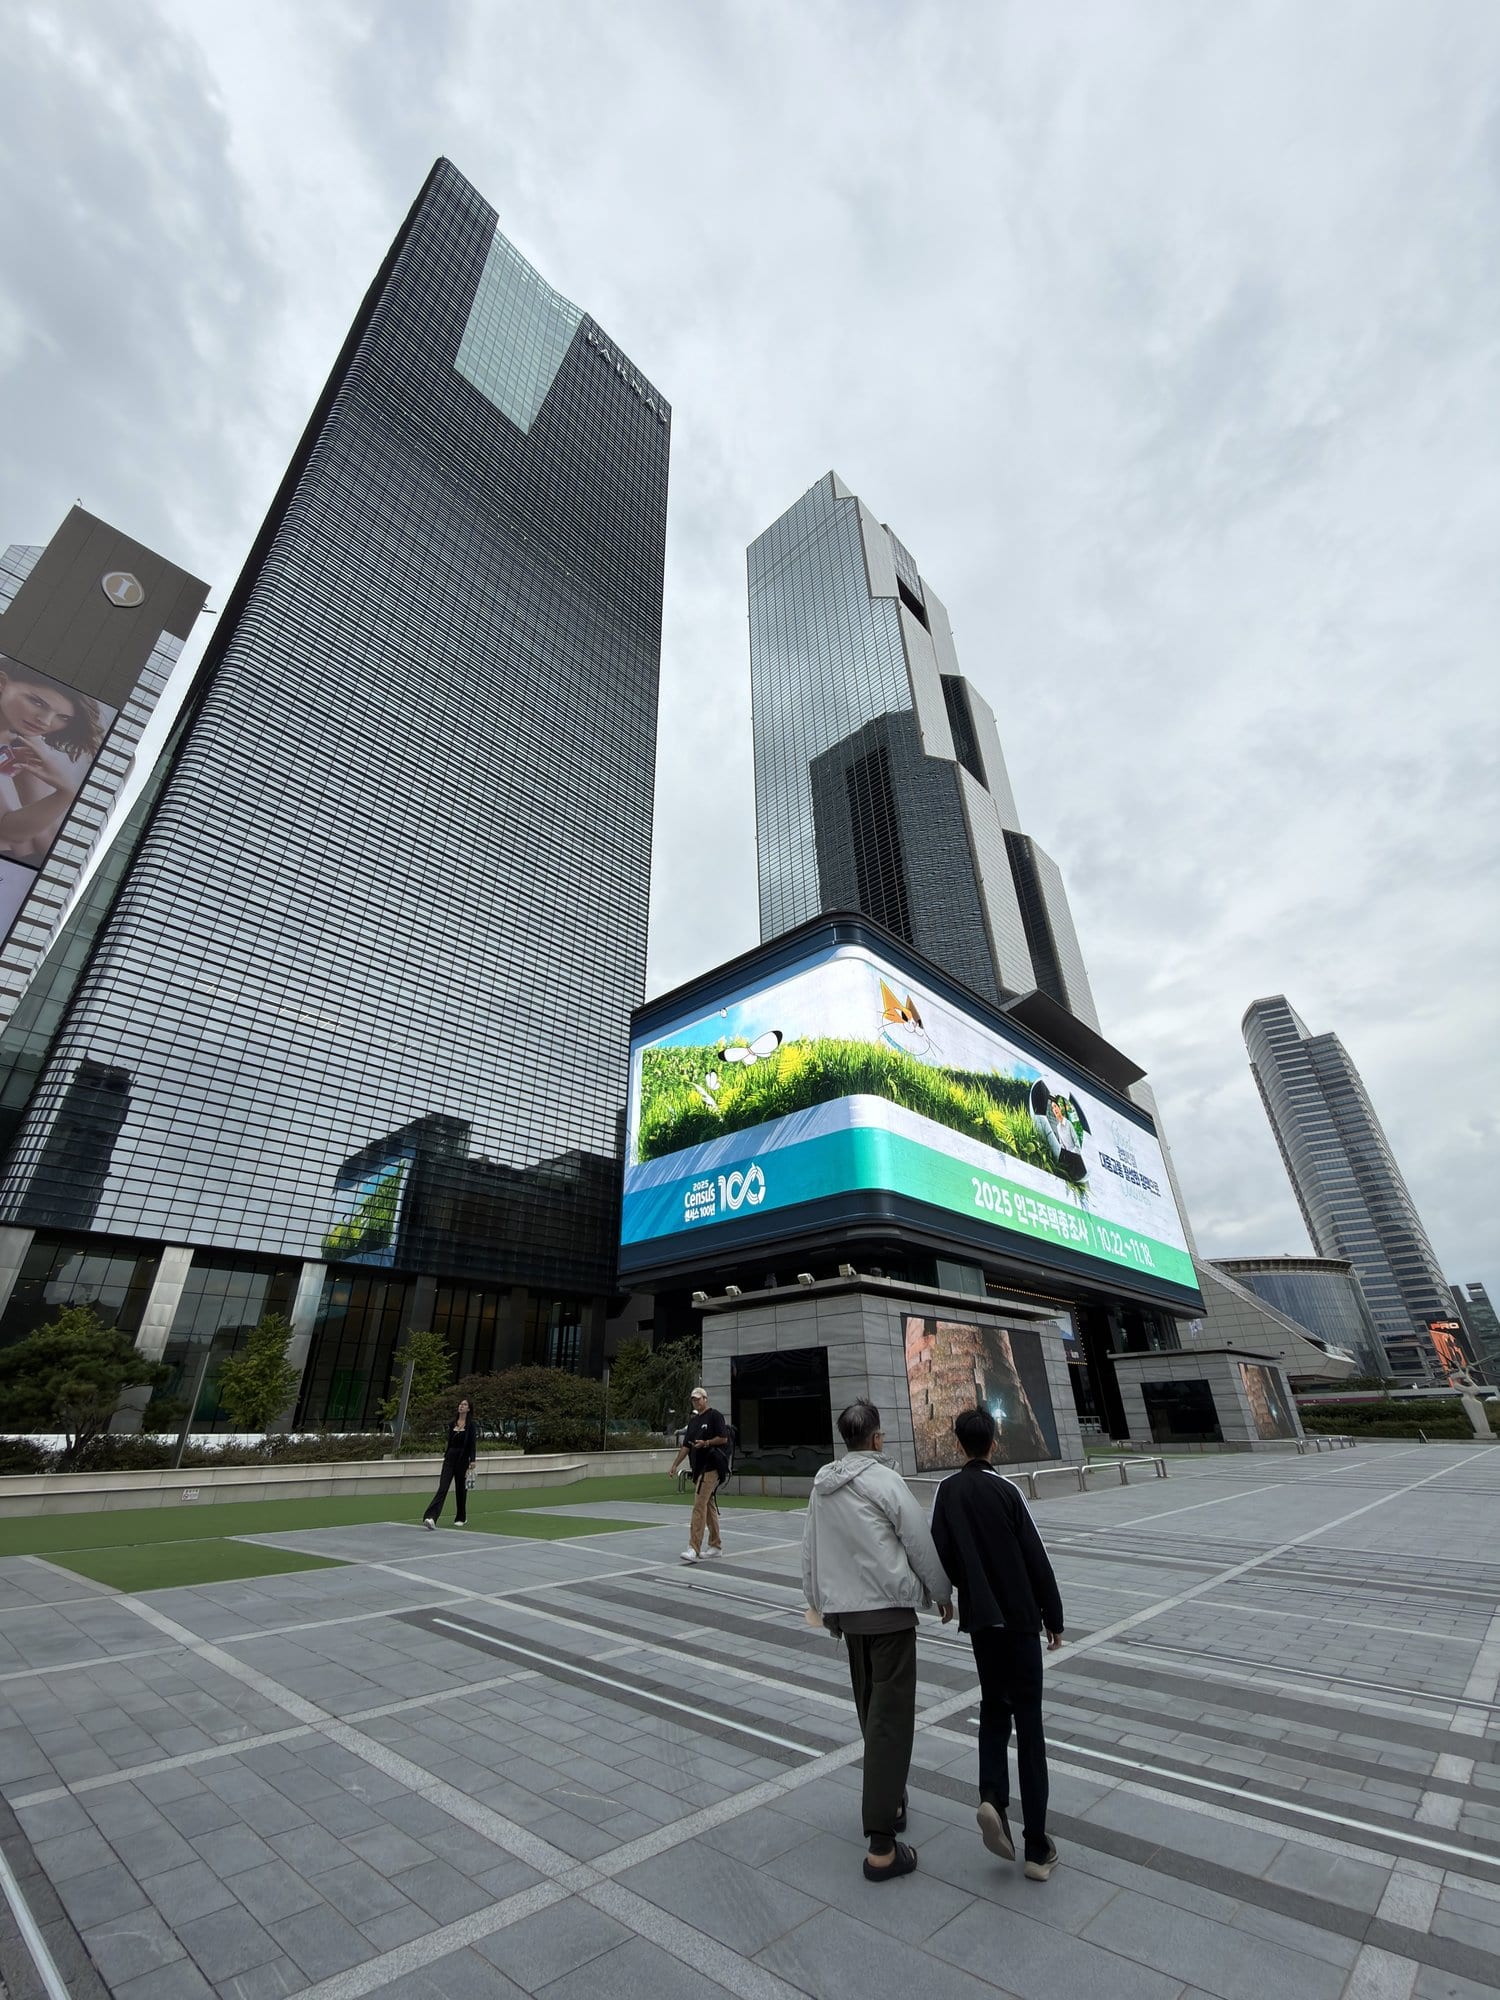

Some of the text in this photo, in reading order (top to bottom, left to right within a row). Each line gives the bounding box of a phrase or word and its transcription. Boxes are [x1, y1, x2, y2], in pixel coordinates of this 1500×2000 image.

[692, 1180, 709, 1191] 2025
[684, 1183, 716, 1209] Census
[700, 1205, 715, 1217] 100년
[972, 1178, 1012, 1217] 2025
[1016, 1194, 1088, 1246] 인구주택총조사
